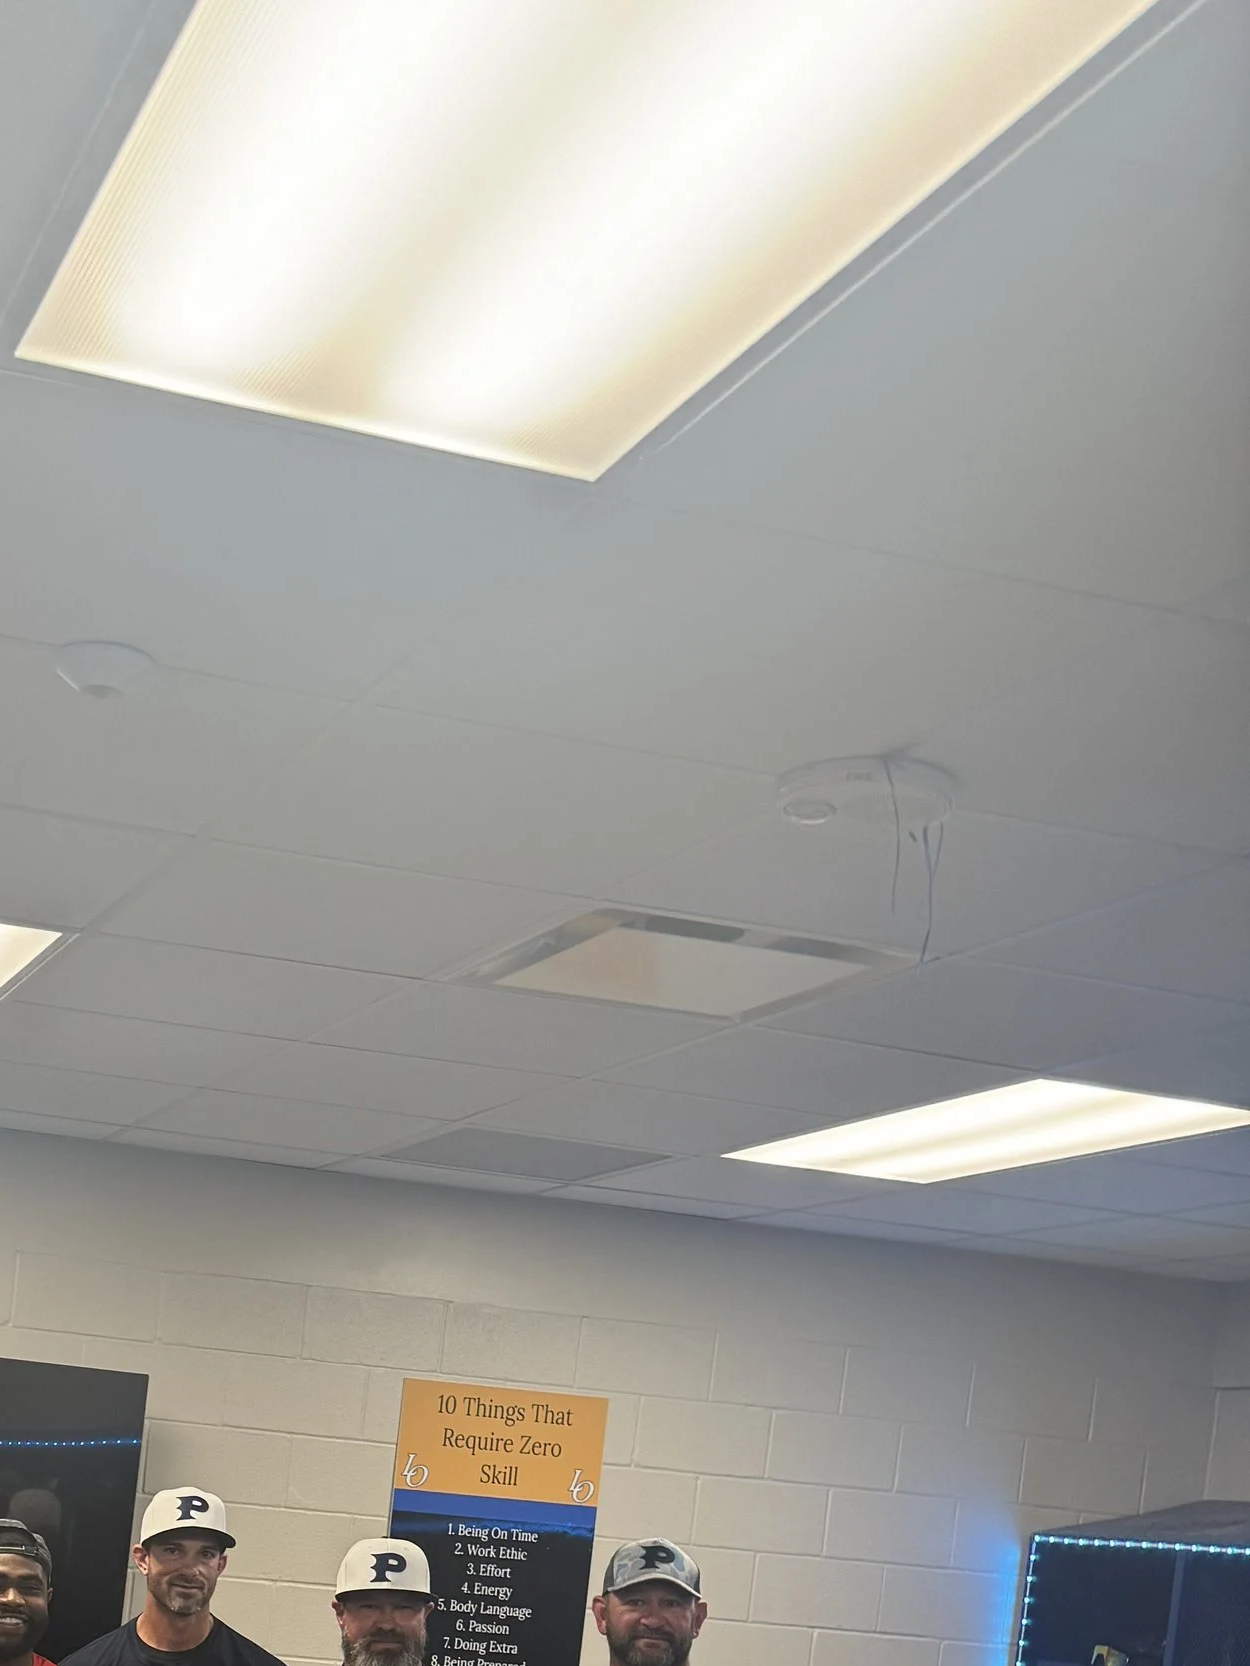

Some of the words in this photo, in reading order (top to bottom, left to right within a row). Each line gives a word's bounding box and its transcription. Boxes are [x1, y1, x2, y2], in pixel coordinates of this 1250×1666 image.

[438, 1394, 457, 1415] 10
[463, 1397, 526, 1427] Things
[531, 1403, 574, 1427] That
[442, 1427, 514, 1456] Require
[519, 1435, 562, 1458] Zero
[480, 1463, 519, 1487] Skill
[175, 1494, 210, 1521] P
[447, 1523, 455, 1535] 1.
[458, 1523, 490, 1542] Being
[491, 1526, 508, 1540] On
[510, 1528, 539, 1543] Time
[454, 1542, 464, 1555] 2.
[467, 1543, 497, 1558] Work
[499, 1546, 528, 1560] Ethic
[638, 1545, 675, 1572] P
[369, 1552, 407, 1583] P
[466, 1562, 476, 1575] 3.
[479, 1563, 511, 1578] Effort
[461, 1582, 471, 1594] 4.
[473, 1582, 513, 1600] Energy
[437, 1598, 447, 1611] 5.
[450, 1599, 478, 1616] Body
[480, 1602, 532, 1621] Language
[456, 1619, 466, 1631] 6.
[469, 1620, 510, 1635] Passion
[443, 1636, 451, 1649] 7.
[454, 1637, 488, 1655] Doing
[489, 1640, 518, 1655] Extra
[431, 1654, 440, 1666] 8.
